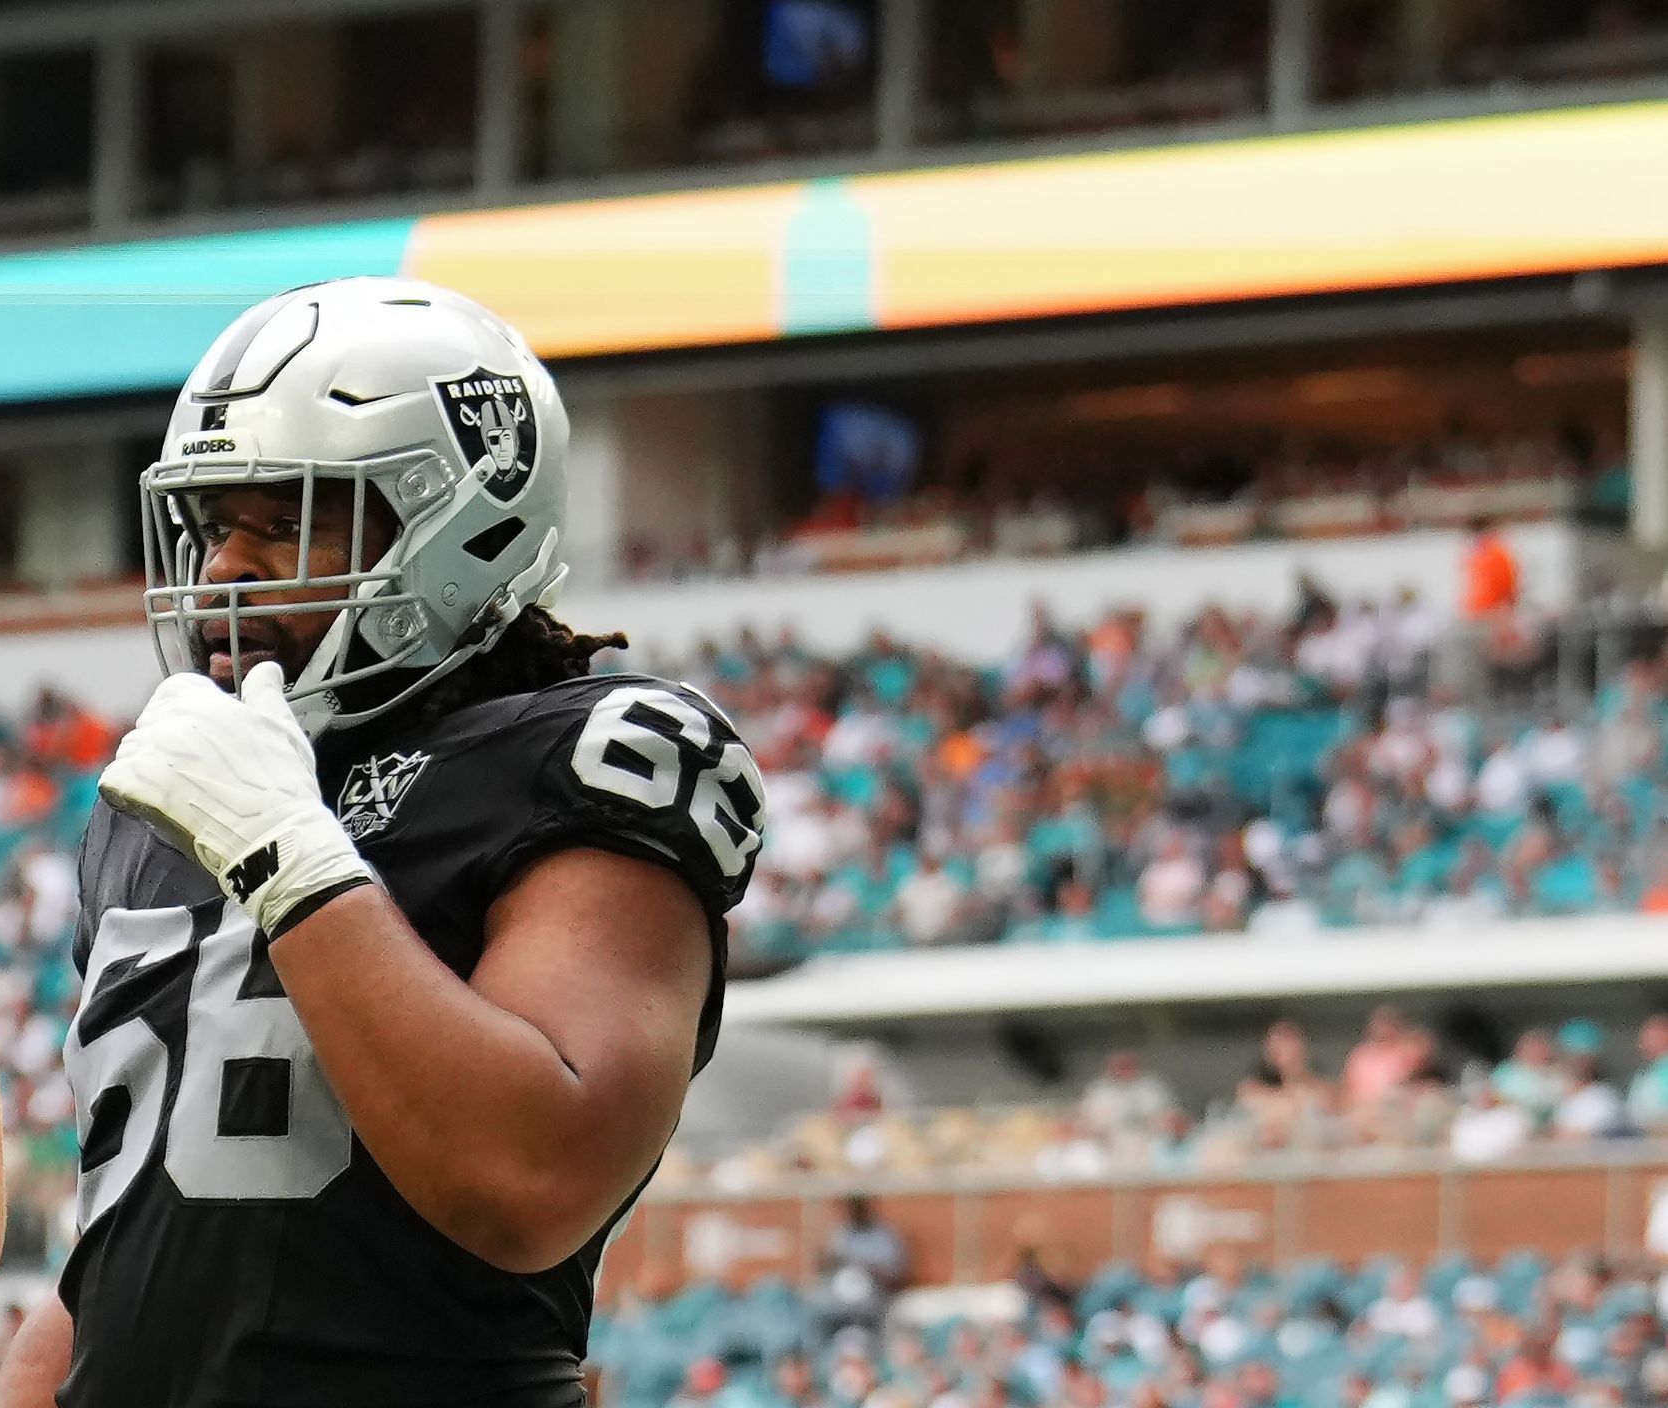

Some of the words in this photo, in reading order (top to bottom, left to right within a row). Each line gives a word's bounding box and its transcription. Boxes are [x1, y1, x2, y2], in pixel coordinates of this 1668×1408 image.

[446, 378, 523, 399] RAIDERS
[181, 438, 237, 457] RAIDERS
[571, 686, 764, 877] 68
